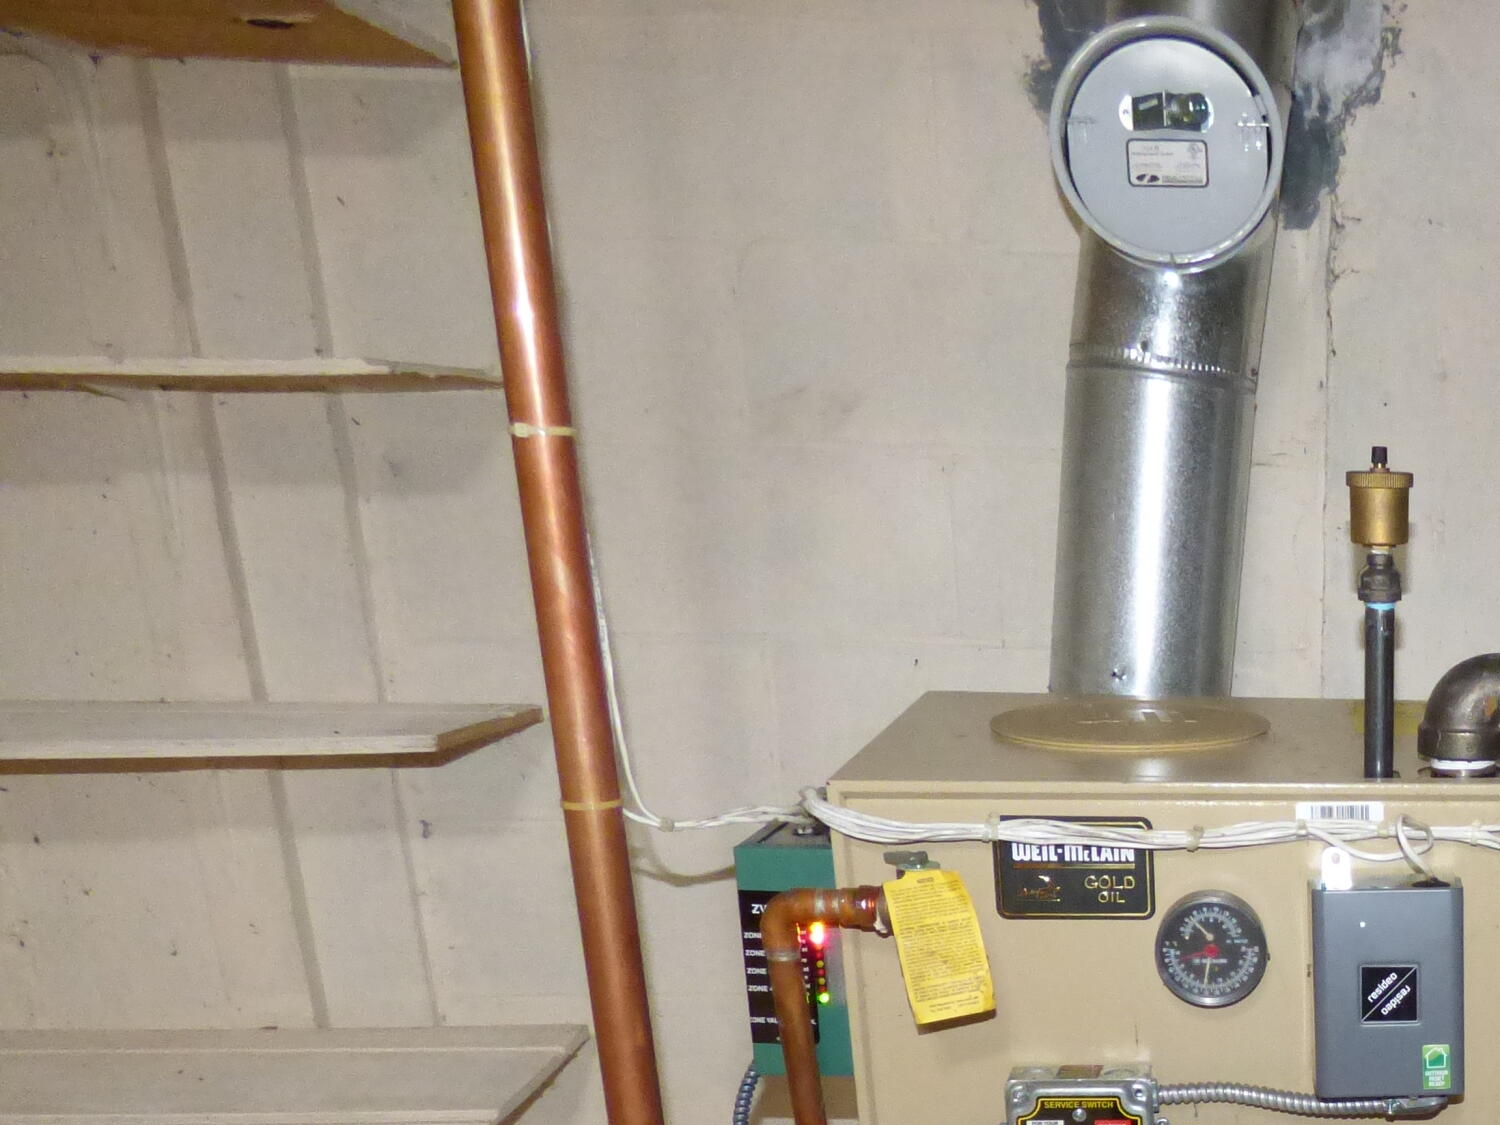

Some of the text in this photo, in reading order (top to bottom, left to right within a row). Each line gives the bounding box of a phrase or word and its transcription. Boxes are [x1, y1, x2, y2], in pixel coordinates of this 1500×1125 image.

[1084, 875, 1136, 890] GOLD
[1097, 891, 1126, 903] OIL
[747, 967, 768, 975] ZONE
[1367, 972, 1398, 1003] resideo
[1381, 985, 1411, 1016] resideo
[1044, 1101, 1114, 1109] SERVICE SWITCH
